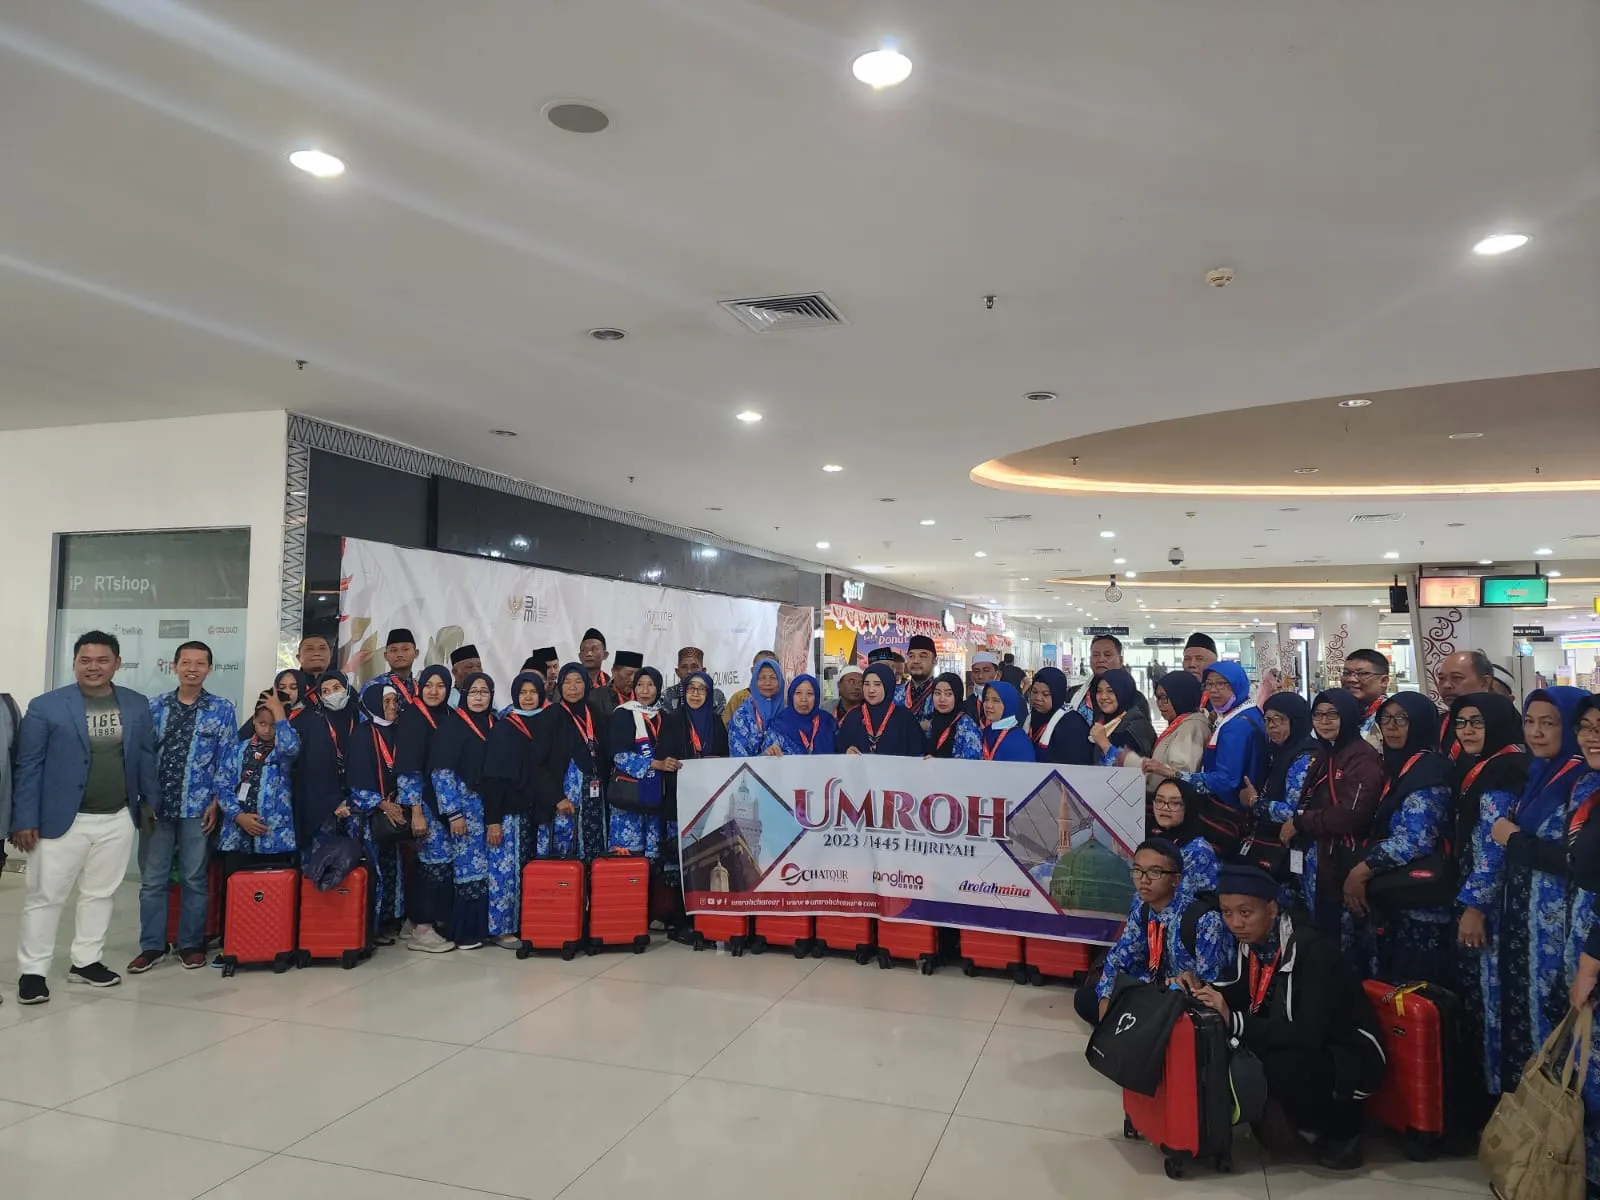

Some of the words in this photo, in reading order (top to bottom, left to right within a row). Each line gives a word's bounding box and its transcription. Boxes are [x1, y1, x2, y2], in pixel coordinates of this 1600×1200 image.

[712, 671, 740, 686] OUNGE
[94, 727, 116, 737] 1989
[793, 776, 1010, 841] UMROH
[823, 832, 860, 848] 2023
[904, 838, 976, 858] HIJRIYAH
